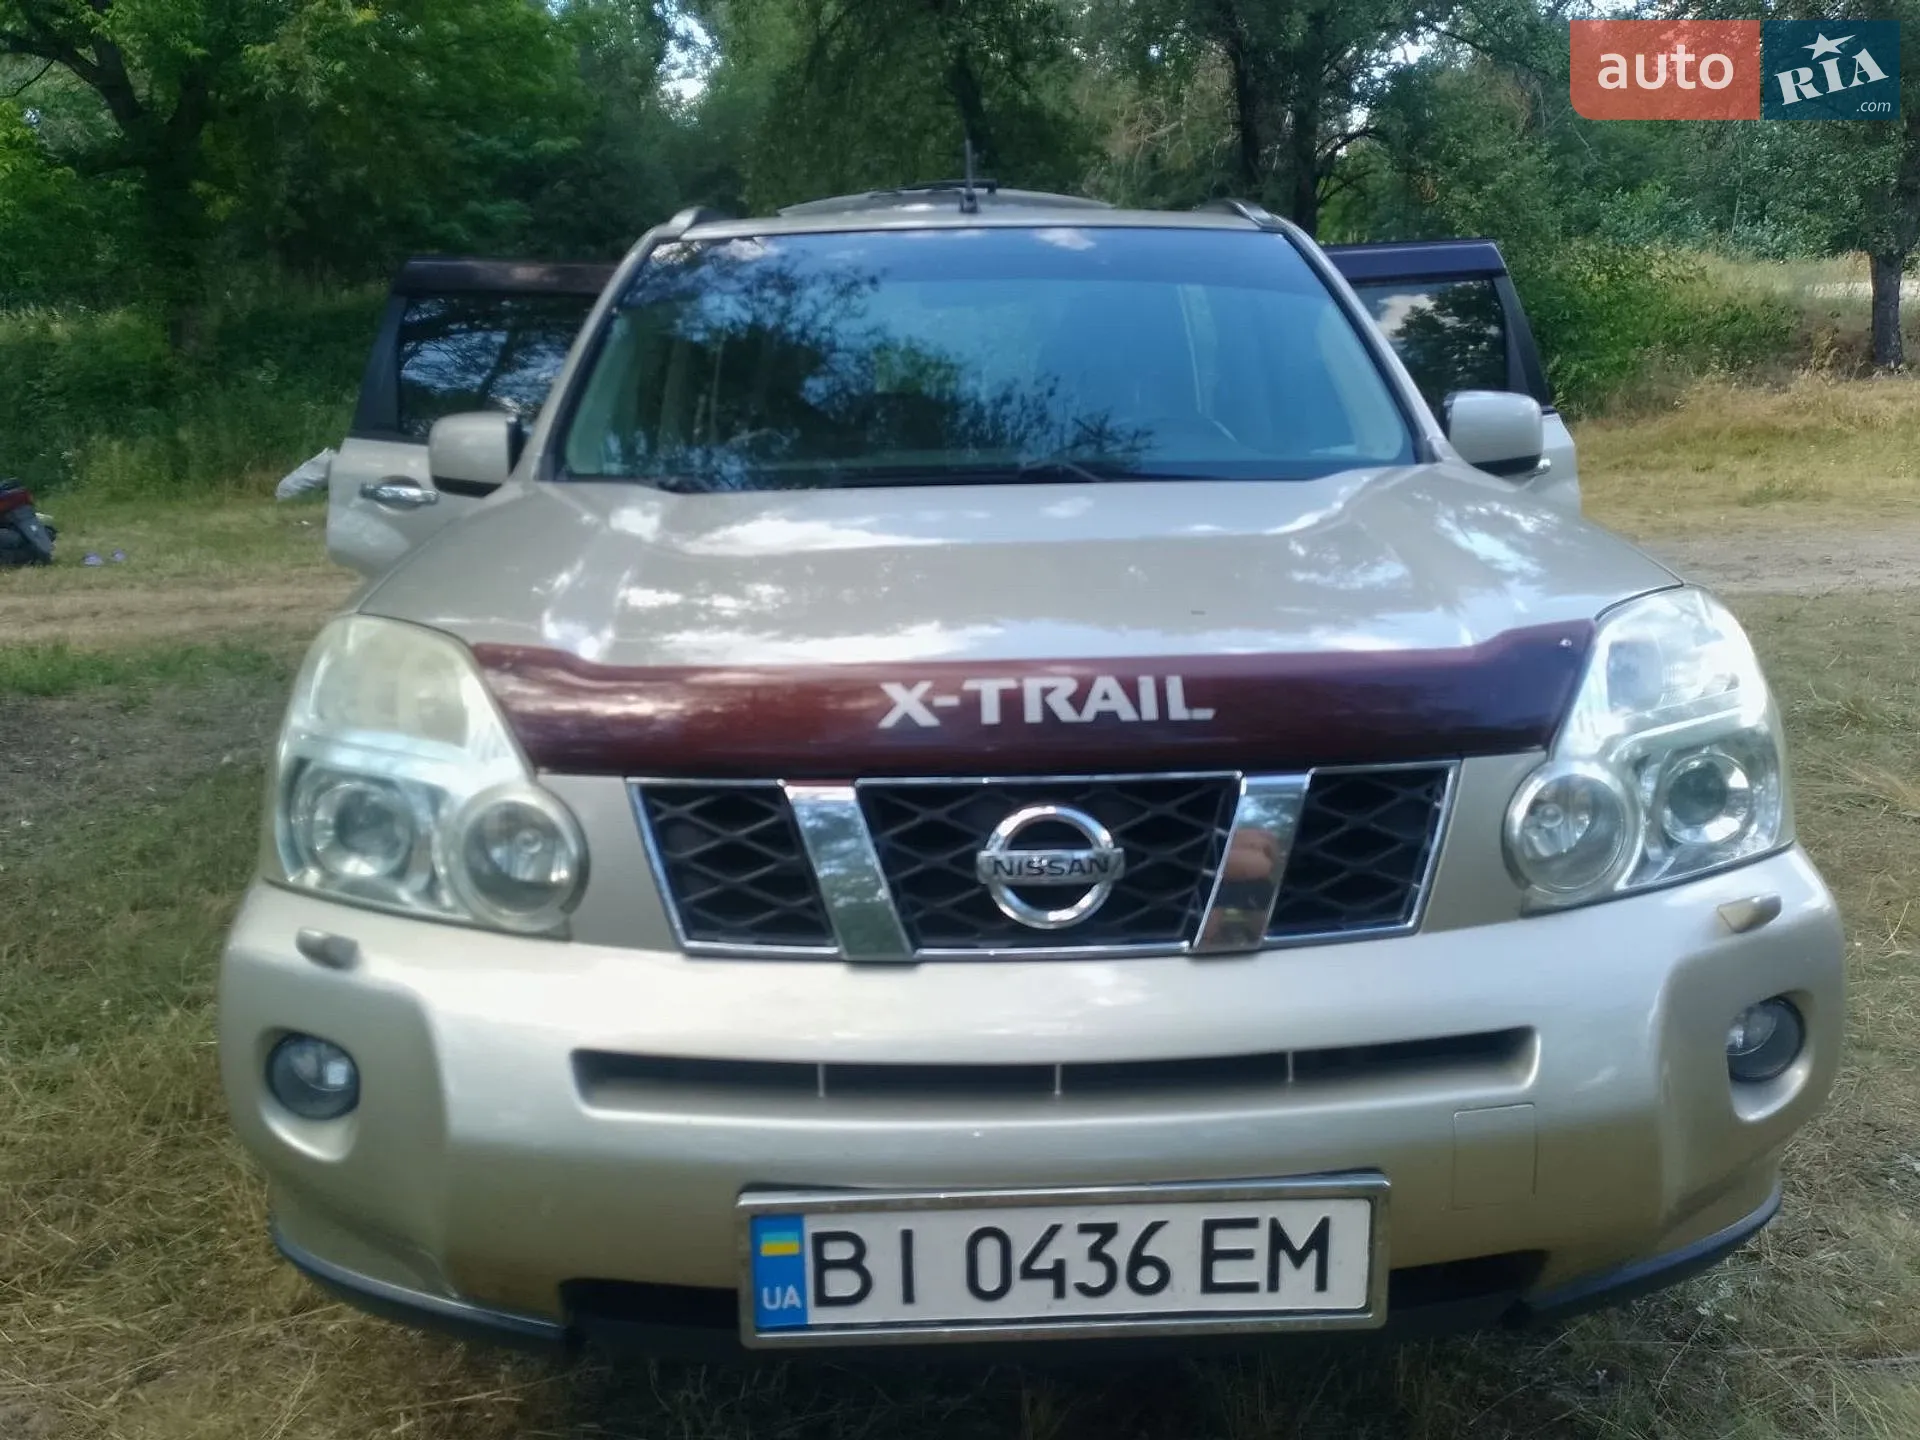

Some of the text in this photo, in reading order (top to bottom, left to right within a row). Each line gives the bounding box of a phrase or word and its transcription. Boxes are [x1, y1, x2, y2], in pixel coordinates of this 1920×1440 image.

[878, 675, 1215, 729] X-TRAIL
[993, 857, 1110, 877] NISSAN
[811, 1215, 1331, 1308] BI 0436 EM
[762, 1284, 801, 1311] UA
